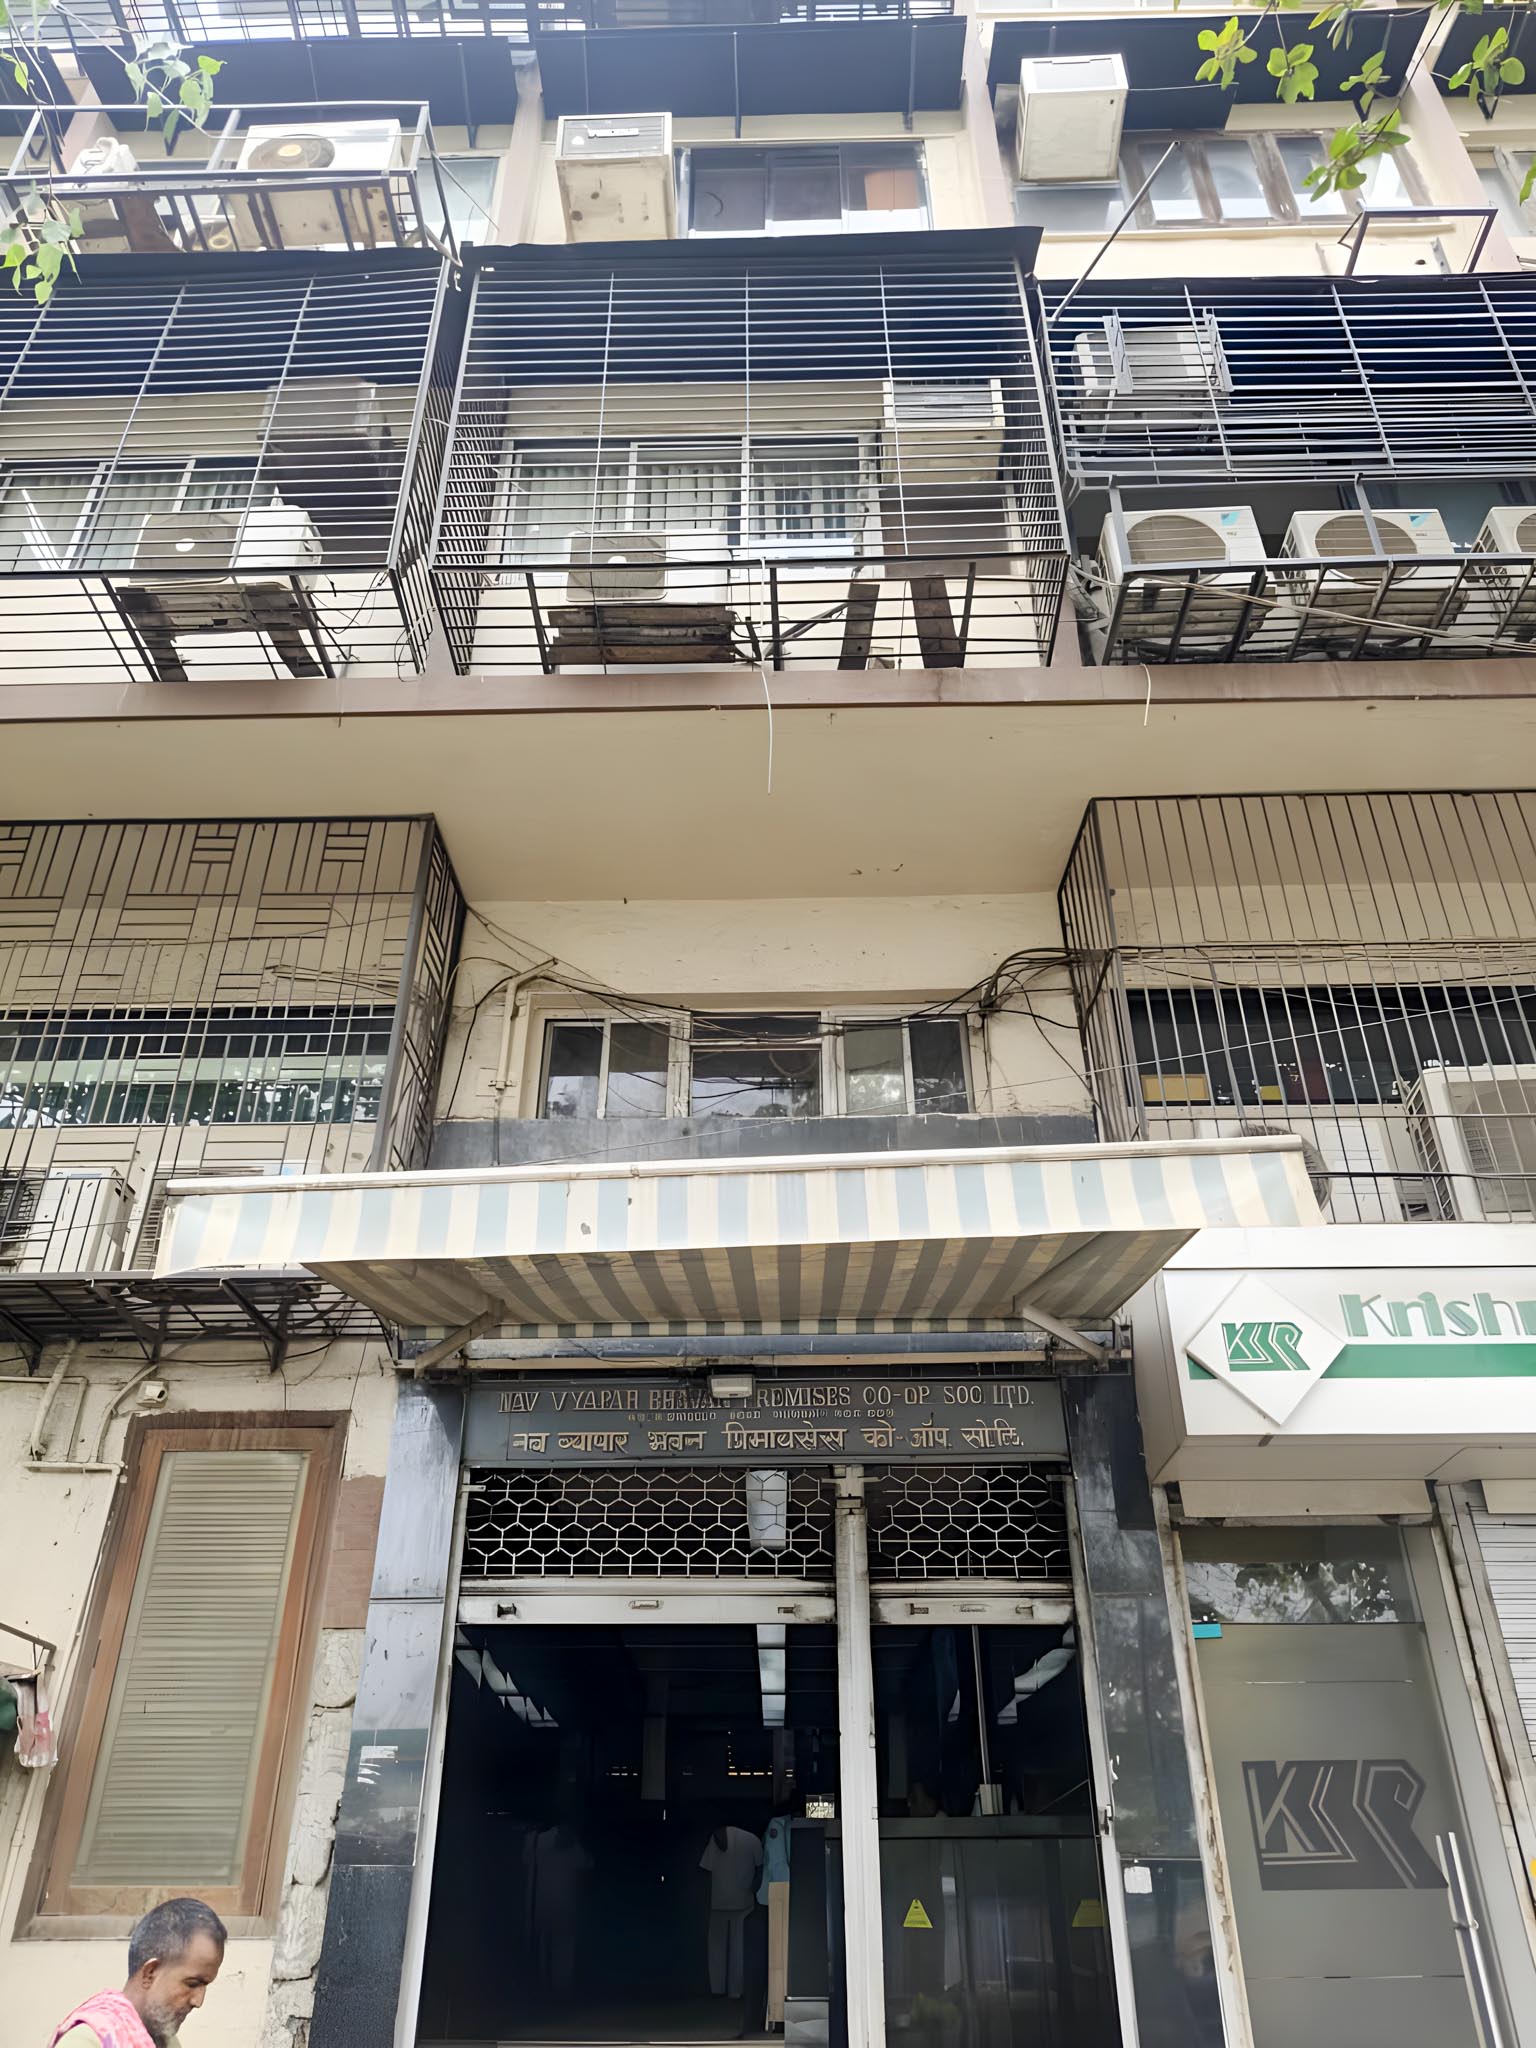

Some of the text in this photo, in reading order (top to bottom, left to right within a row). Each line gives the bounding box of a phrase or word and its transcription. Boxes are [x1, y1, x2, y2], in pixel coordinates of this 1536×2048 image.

[499, 1391, 539, 1412] NAV
[743, 1386, 850, 1409] REMISES
[512, 1432, 550, 1453] नव
[557, 1431, 629, 1454] व्यापार
[648, 1431, 707, 1451] भवन
